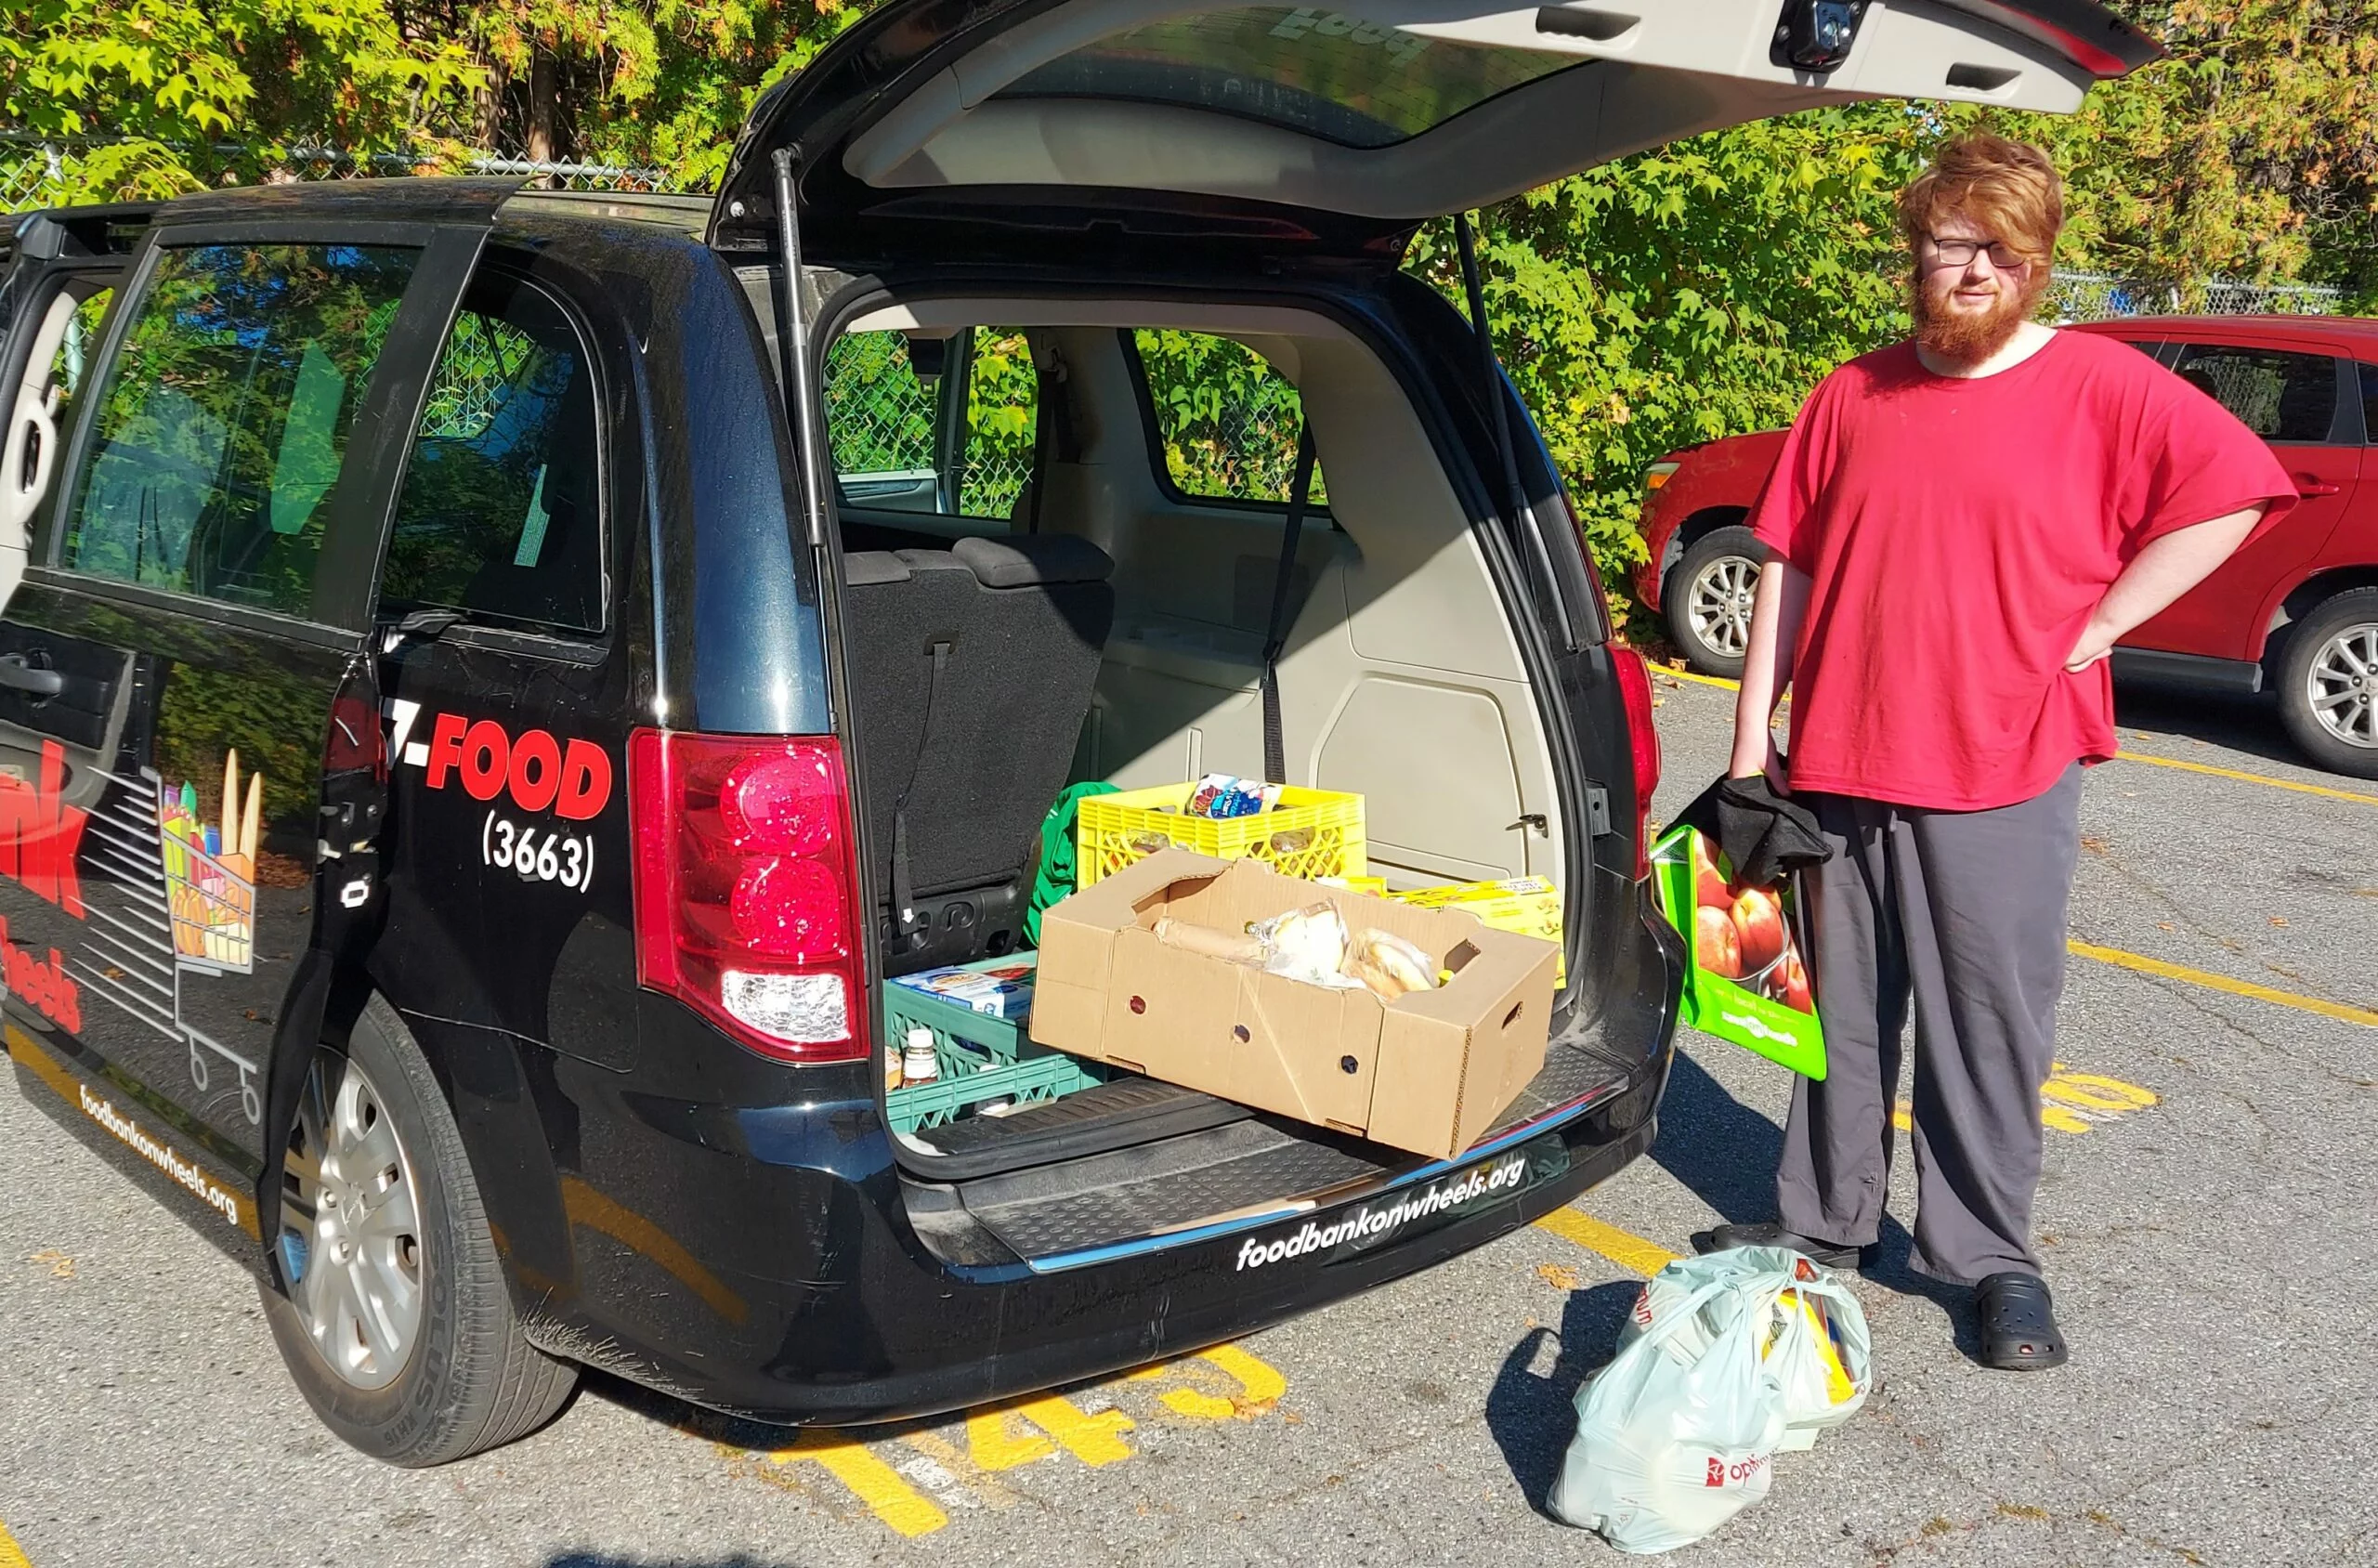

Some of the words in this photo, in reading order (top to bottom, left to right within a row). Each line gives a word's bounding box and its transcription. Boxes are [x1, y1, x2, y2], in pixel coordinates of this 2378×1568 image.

[483, 808, 594, 894] (3663)
[80, 1084, 238, 1225] foodbankonwheels.org
[1235, 1158, 1526, 1272] foodbankonwheels.org
